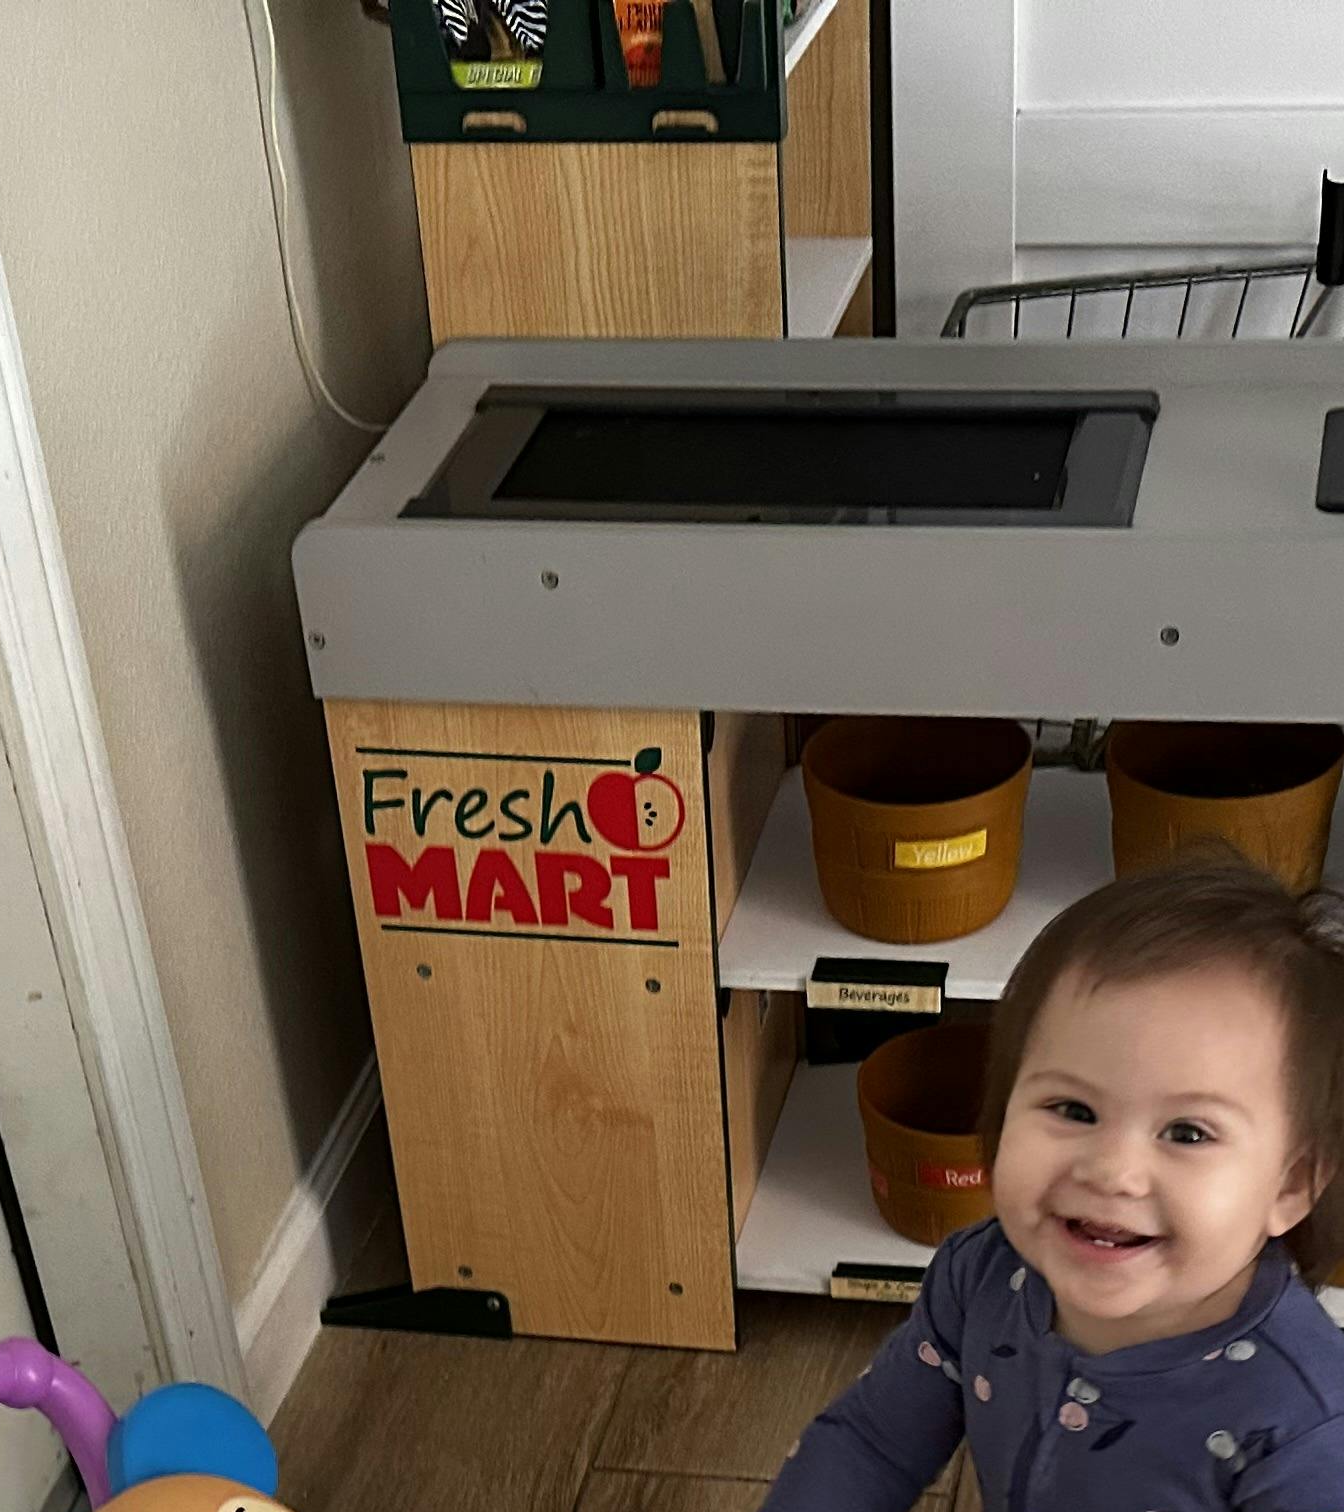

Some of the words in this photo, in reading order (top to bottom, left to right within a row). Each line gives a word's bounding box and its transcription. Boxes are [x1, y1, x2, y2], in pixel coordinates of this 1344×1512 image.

[362, 769, 592, 844] Fresh
[912, 841, 974, 866] Yellow
[364, 842, 671, 932] MART
[838, 987, 911, 1006] Beverages
[945, 1168, 982, 1188] Red
